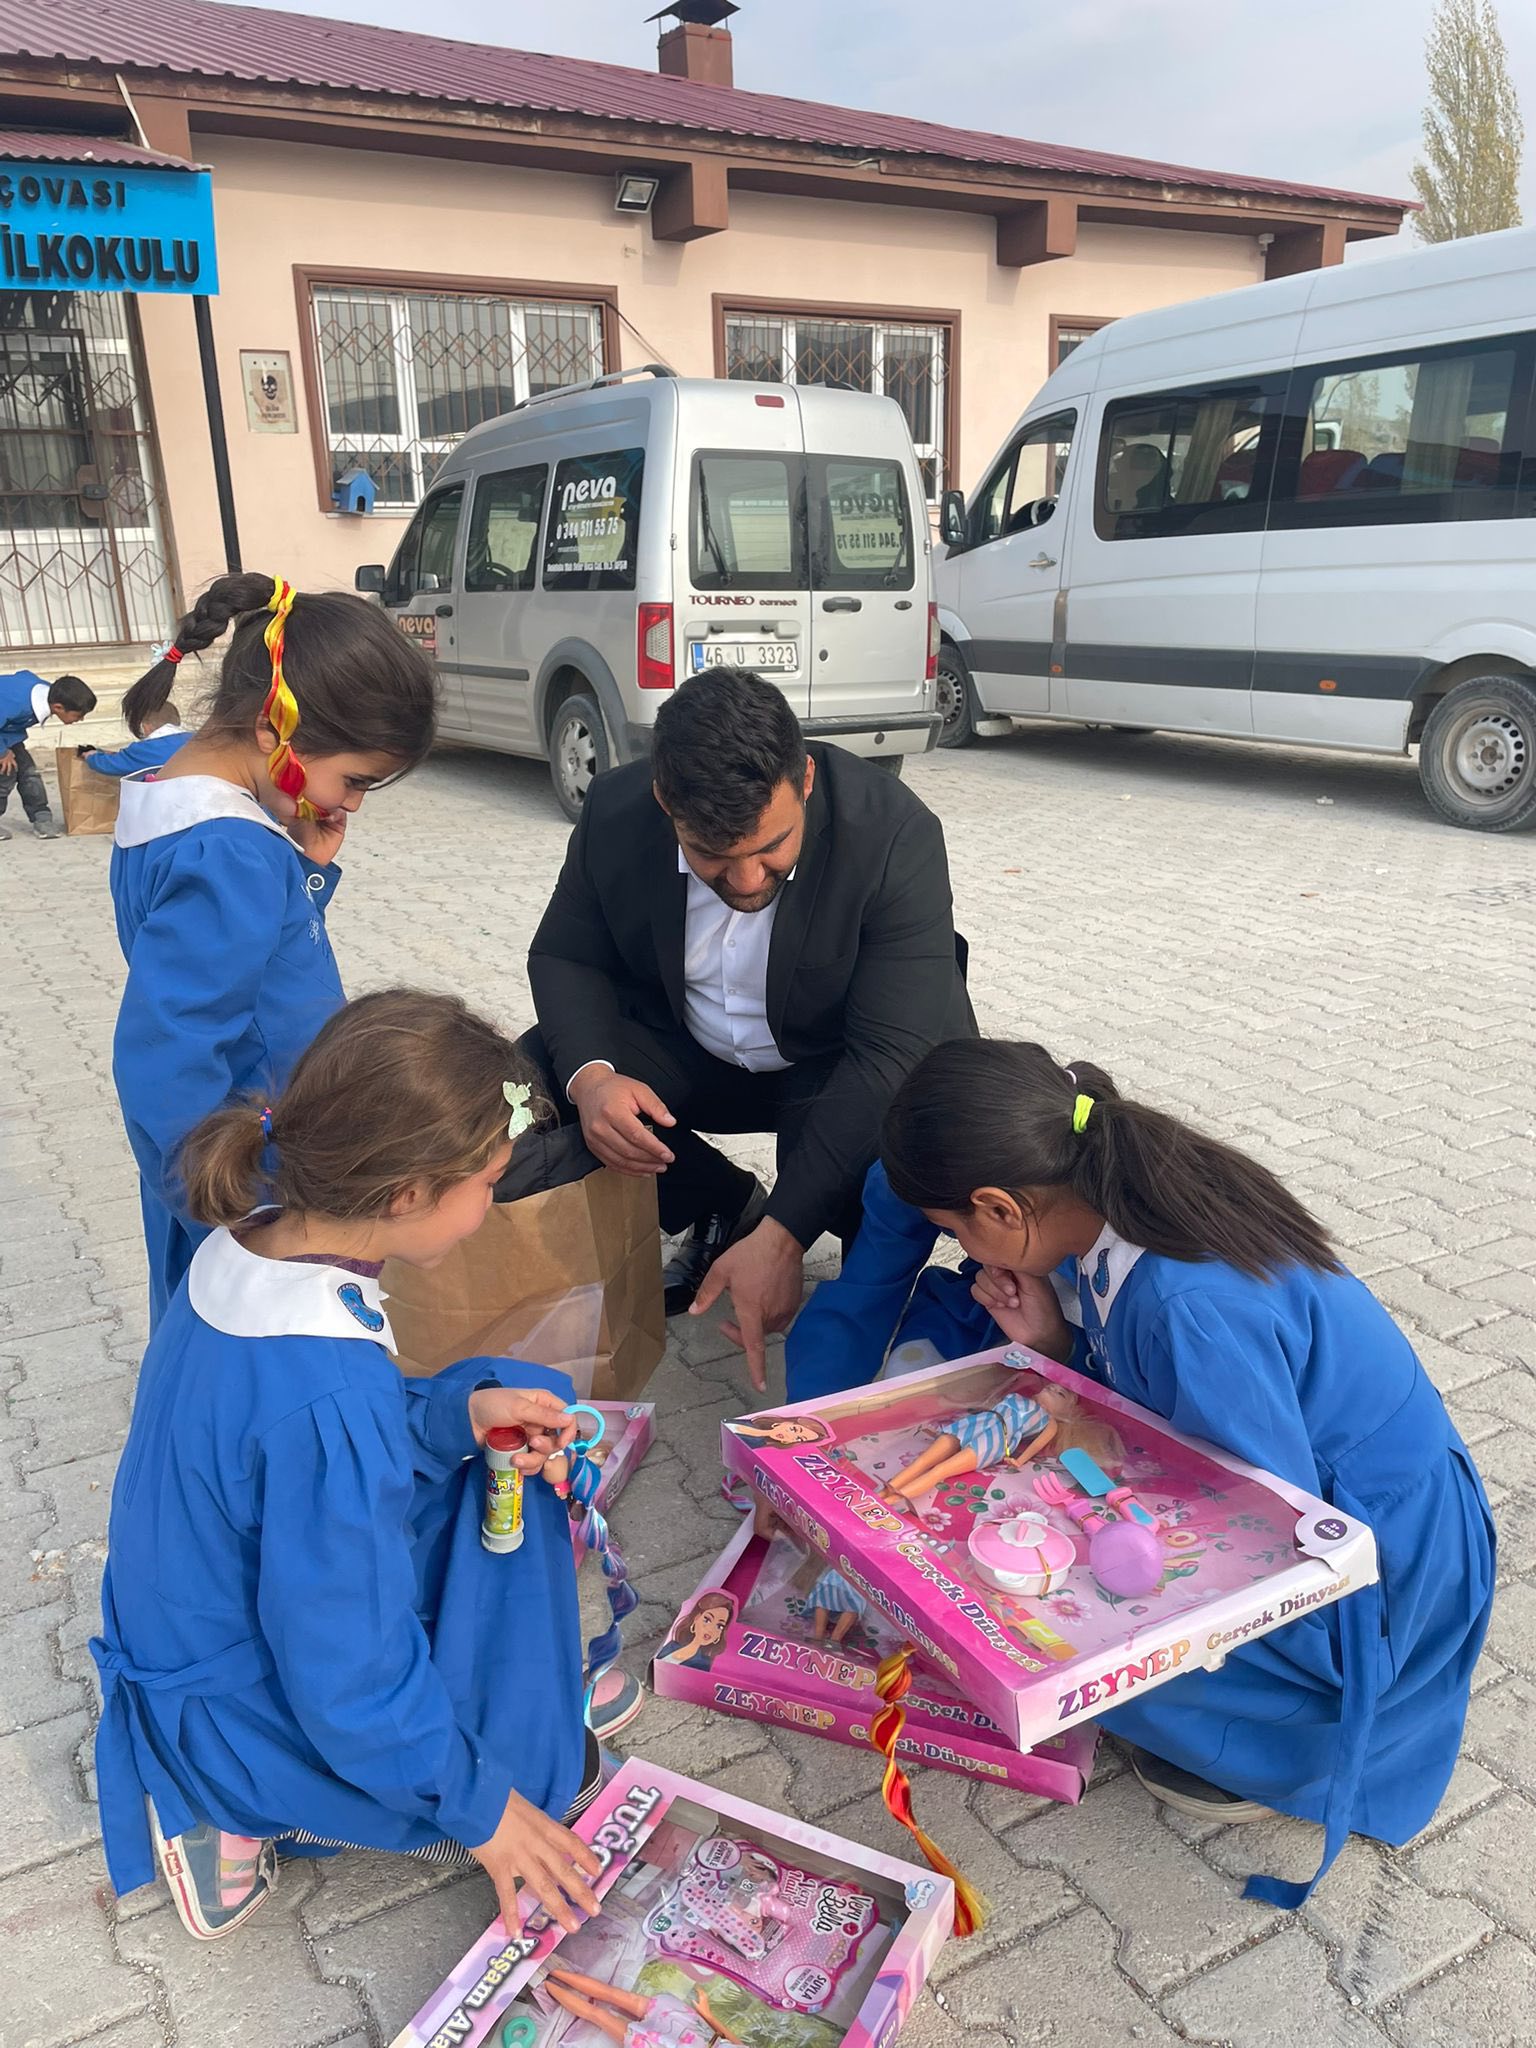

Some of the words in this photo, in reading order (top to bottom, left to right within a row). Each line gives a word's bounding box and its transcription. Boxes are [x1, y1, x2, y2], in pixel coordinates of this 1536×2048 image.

[1, 224, 200, 284] İLKOKULU
[562, 476, 616, 511] neva
[556, 523, 562, 540] 0
[563, 522, 579, 540] 344
[580, 519, 593, 537] 511
[594, 518, 606, 536] 55
[607, 516, 619, 535] 75
[689, 595, 755, 606] TOURNEO
[759, 599, 797, 607] connect
[399, 617, 434, 634] neva
[706, 647, 723, 665] 46
[736, 646, 745, 665] U
[758, 646, 794, 664] 3323
[754, 1465, 831, 1553] ZEYNEP
[839, 1554, 891, 1613] Gerçek
[793, 1454, 904, 1532] ZEYNEP
[897, 1543, 965, 1602] Gerçek
[957, 1601, 1047, 1673] Dünyası
[1058, 1640, 1191, 1720] ZEYNEP
[1206, 1610, 1275, 1649] Gerçek
[1279, 1575, 1351, 1618] Dünyası
[738, 1632, 876, 1690] ZEYNEP
[904, 1694, 969, 1722] erçek
[714, 1683, 836, 1730] ZEYNEP
[924, 1742, 1008, 1779] Dünyası
[812, 1888, 847, 1932] Bella
[840, 1896, 871, 1921] Very
[463, 1937, 539, 2008] Yaşam
[801, 1974, 827, 2000] SUYLA
